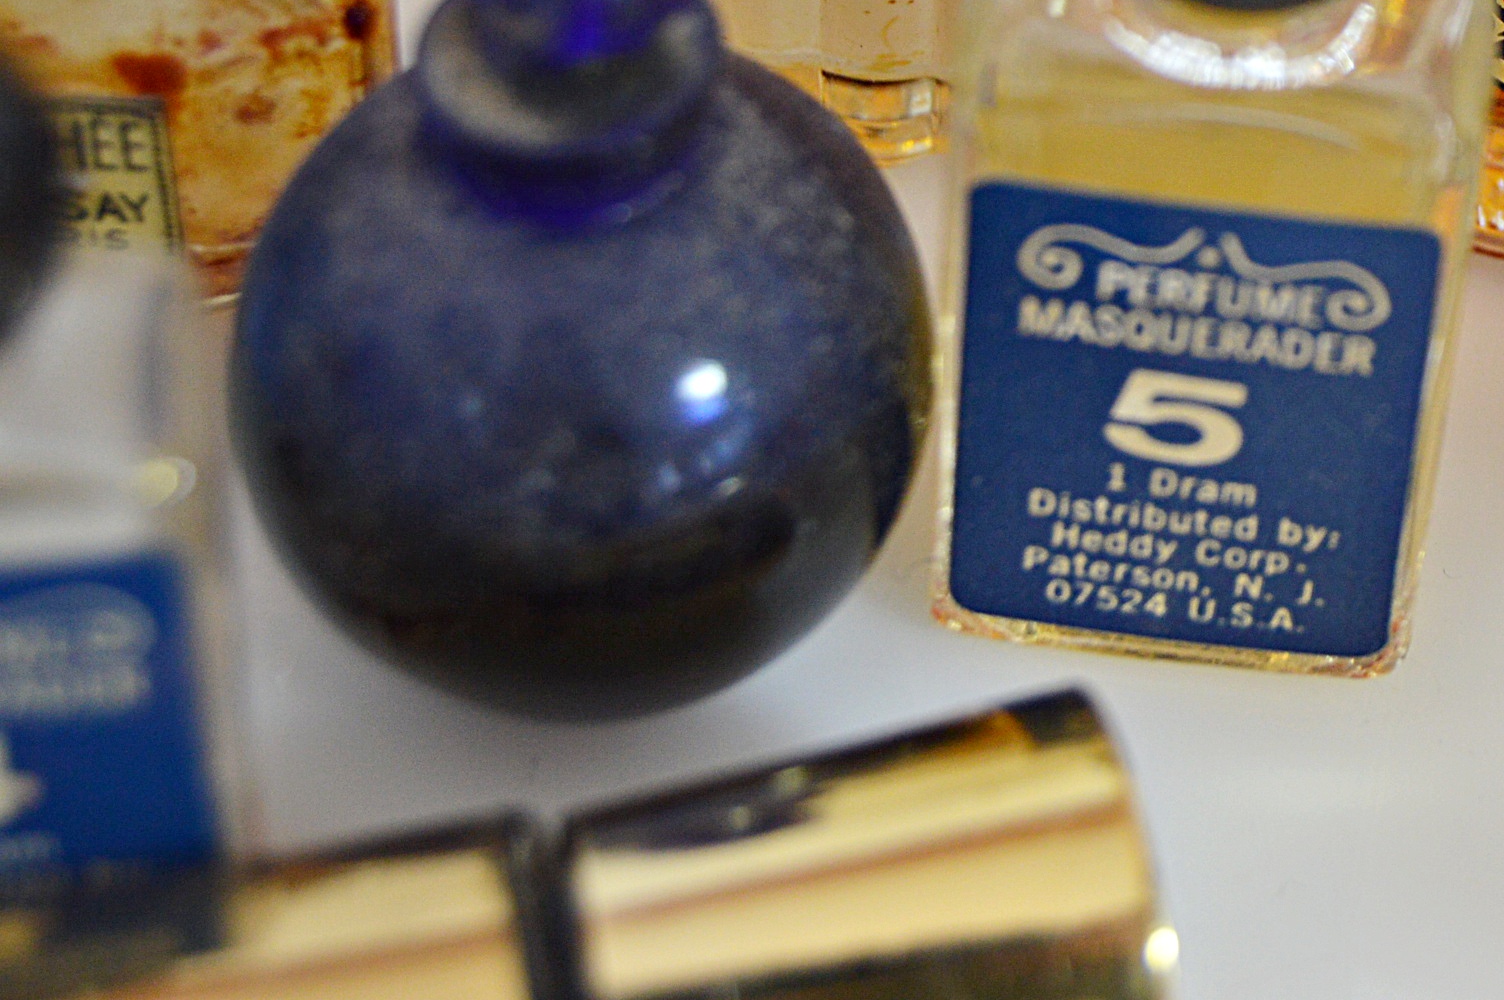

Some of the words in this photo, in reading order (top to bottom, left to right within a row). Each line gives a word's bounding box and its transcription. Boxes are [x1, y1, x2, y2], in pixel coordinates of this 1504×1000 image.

[1096, 257, 1325, 329] PERFUME
[1016, 294, 1378, 378] MASQUERADER
[1103, 367, 1248, 467] 5
[1106, 462, 1127, 493] 1
[1149, 467, 1258, 508] Dram
[1027, 487, 1259, 542] Distributed
[1278, 516, 1341, 552] by:
[1051, 520, 1178, 565] Heddy
[1194, 539, 1308, 576] Corp.
[1022, 546, 1210, 597] Paterson,
[1044, 577, 1168, 619] 07524
[1187, 597, 1304, 633] U.S.A.
